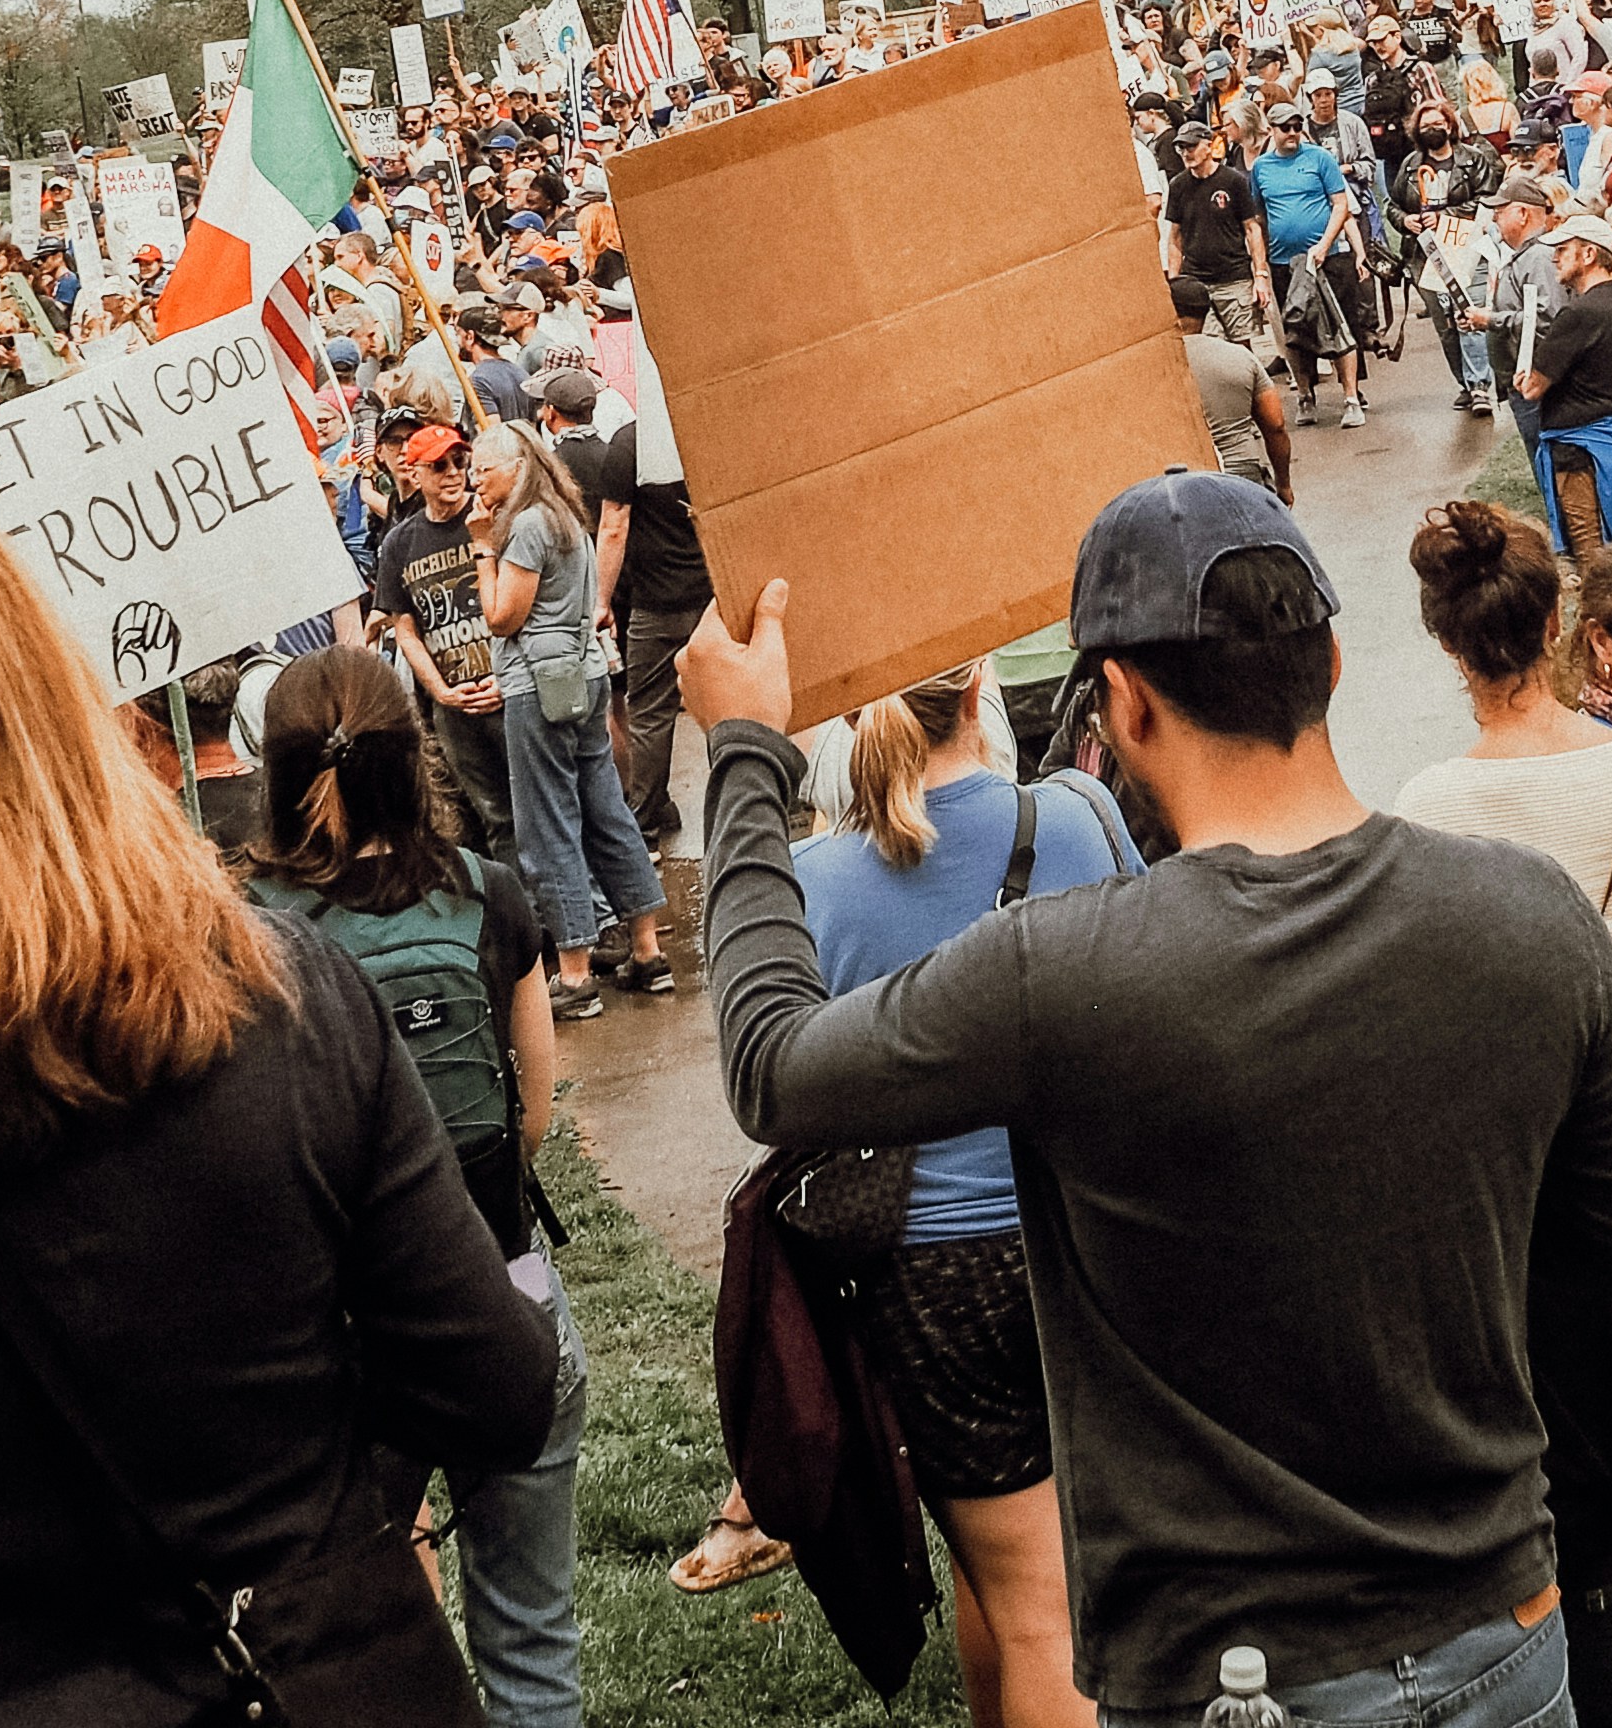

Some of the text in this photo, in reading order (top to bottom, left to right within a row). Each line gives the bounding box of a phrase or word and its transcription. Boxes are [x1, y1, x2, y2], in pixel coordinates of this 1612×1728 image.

[1283, 2, 1320, 21] IGRANTS
[1246, 15, 1254, 40] 4
[112, 103, 136, 122] NOT
[346, 111, 391, 129] ISTORY
[137, 112, 174, 138] GREAT
[376, 144, 395, 154] YOU
[104, 169, 147, 183] MAGA
[107, 180, 172, 196] MARSHA
[64, 390, 141, 454] IN
[154, 335, 269, 415] GOOD
